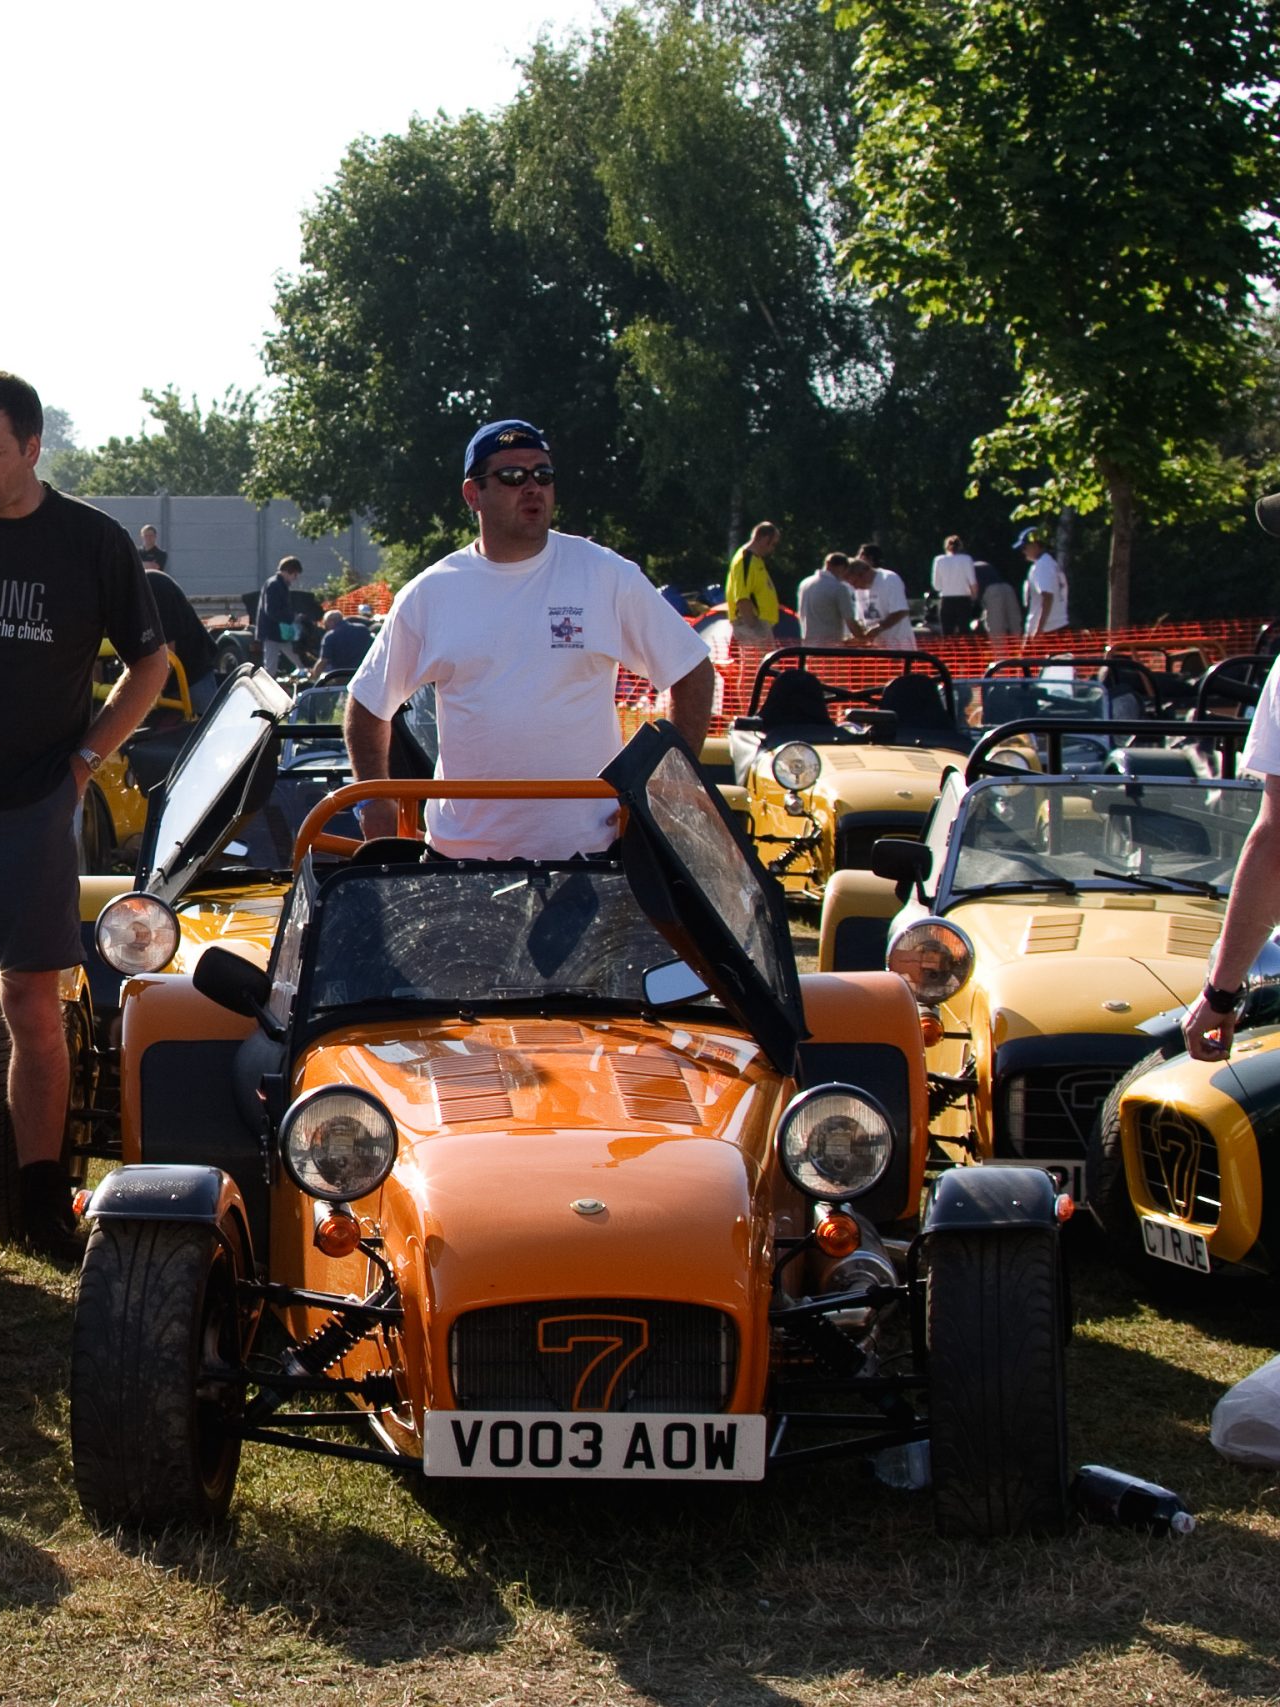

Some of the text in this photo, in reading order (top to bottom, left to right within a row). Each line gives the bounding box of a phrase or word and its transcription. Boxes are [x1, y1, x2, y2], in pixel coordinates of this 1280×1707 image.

[17, 621, 54, 643] chicks.
[1143, 1220, 1209, 1271] C7 RJE
[537, 1314, 650, 1412] 7
[623, 1421, 738, 1471] AOW
